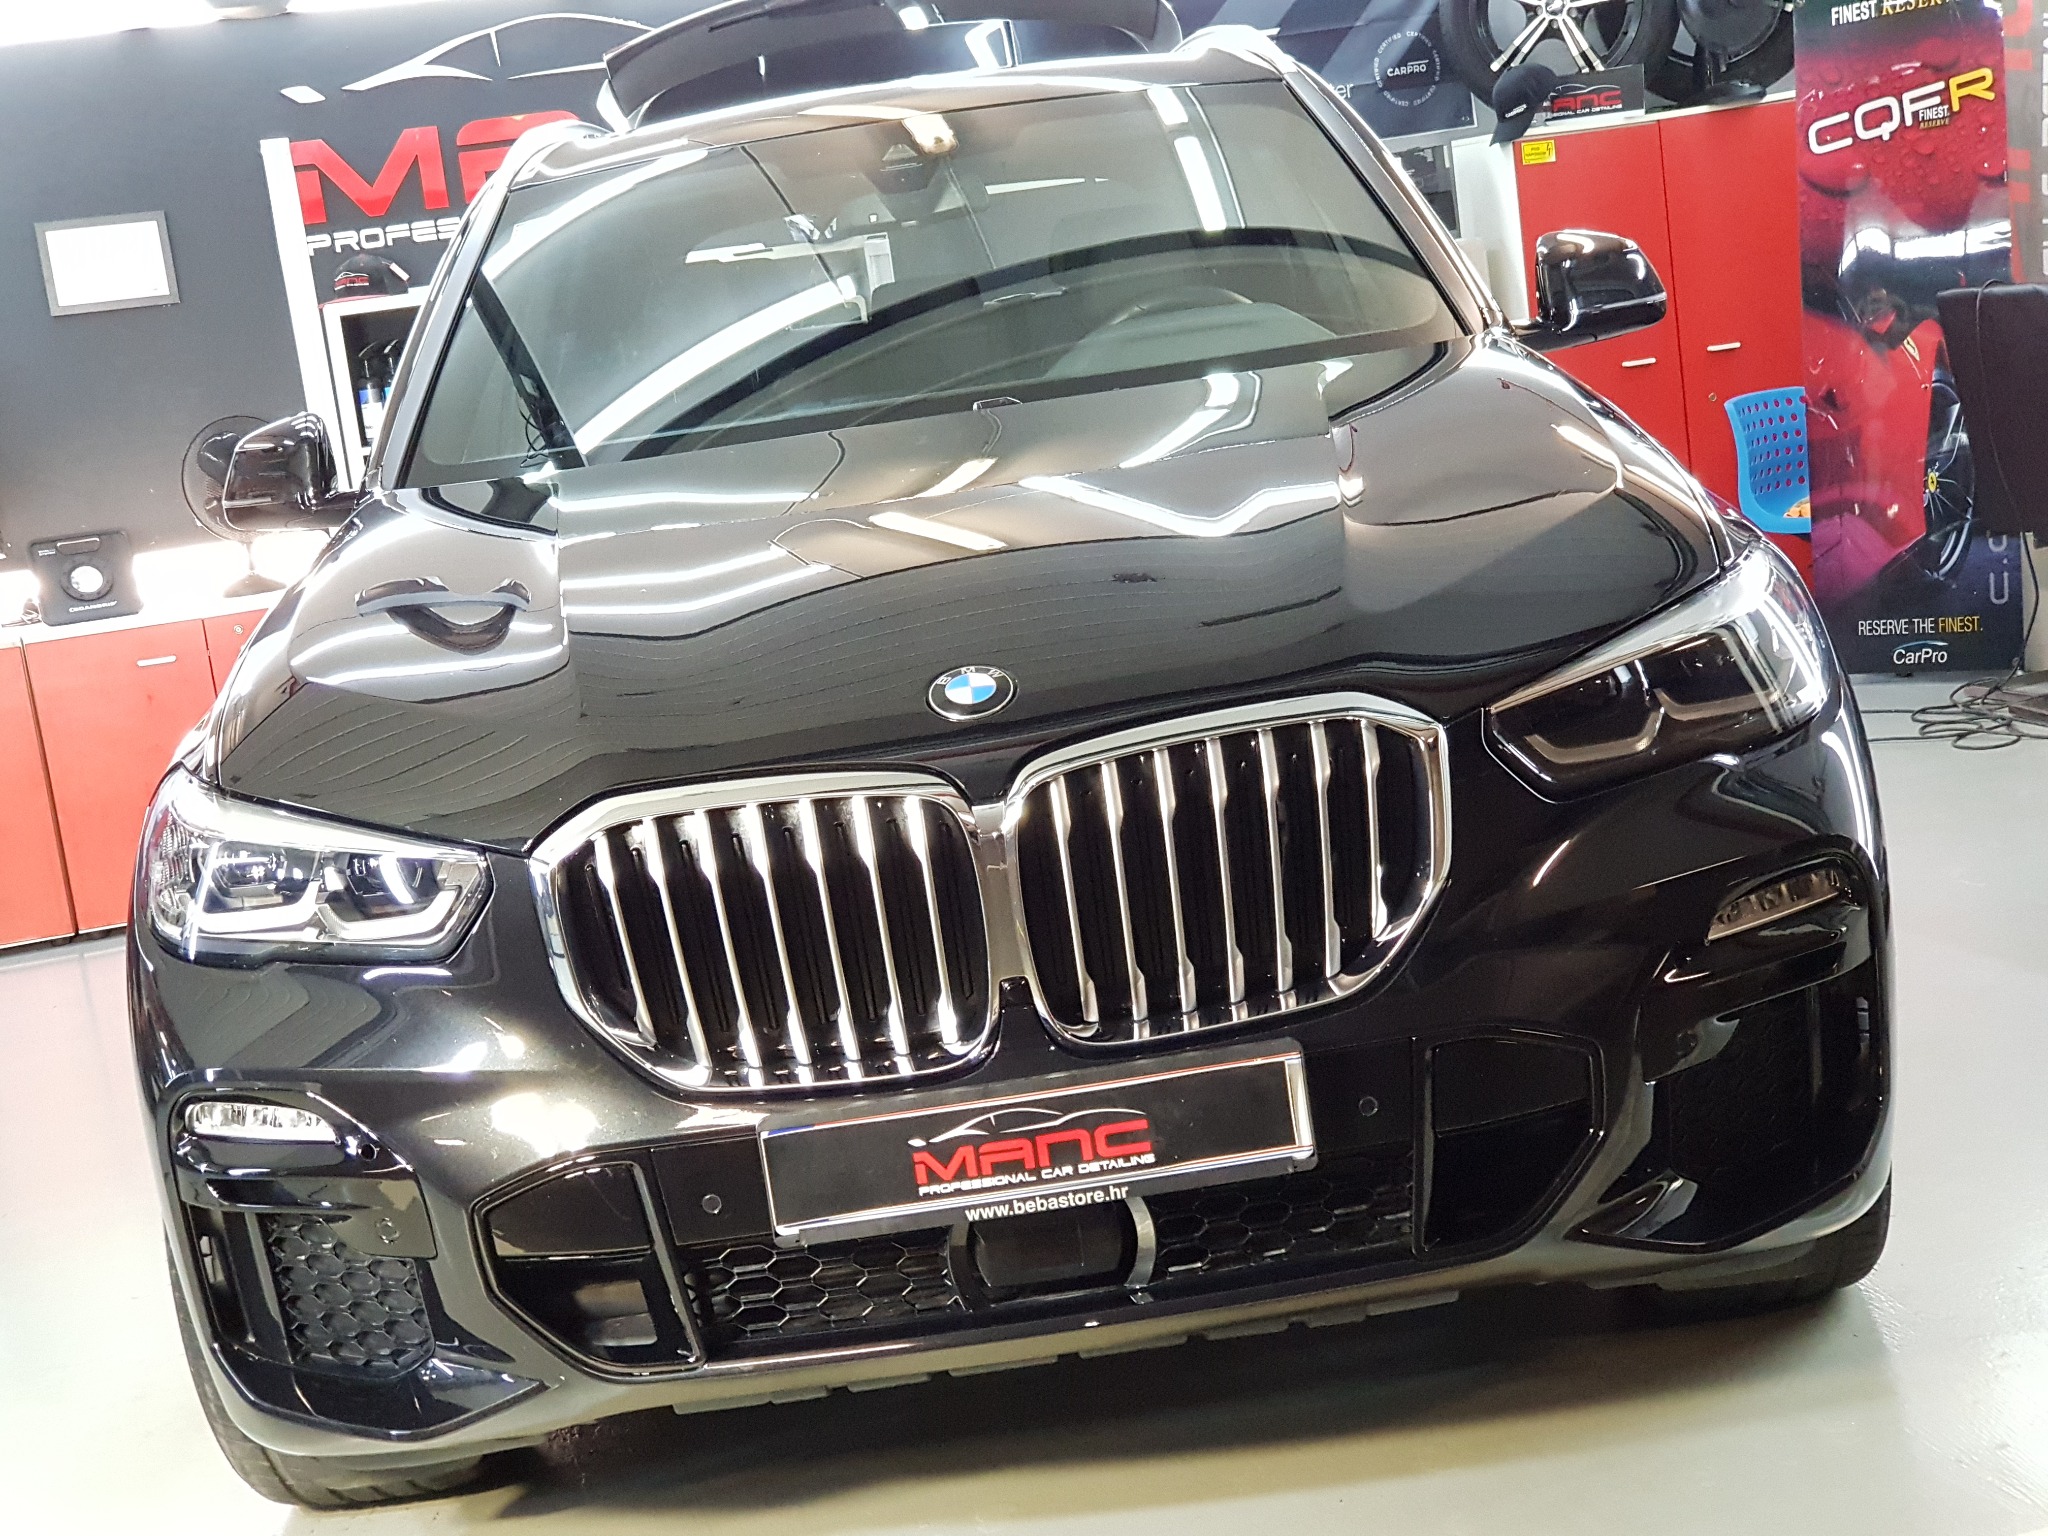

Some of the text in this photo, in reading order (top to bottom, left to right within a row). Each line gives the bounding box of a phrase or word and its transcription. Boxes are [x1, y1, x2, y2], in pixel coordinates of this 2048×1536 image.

[1831, 0, 1877, 26] FINEST
[1386, 64, 1427, 77] CARPRO
[1858, 616, 1984, 636] RESERVE THE FINEST.
[1892, 648, 1948, 665] CarPro
[912, 1119, 1152, 1185] MANC
[919, 1153, 1156, 1197] PROFESSIONAL CAR DETAILING
[965, 1185, 1130, 1222] www.bebastore.hr
